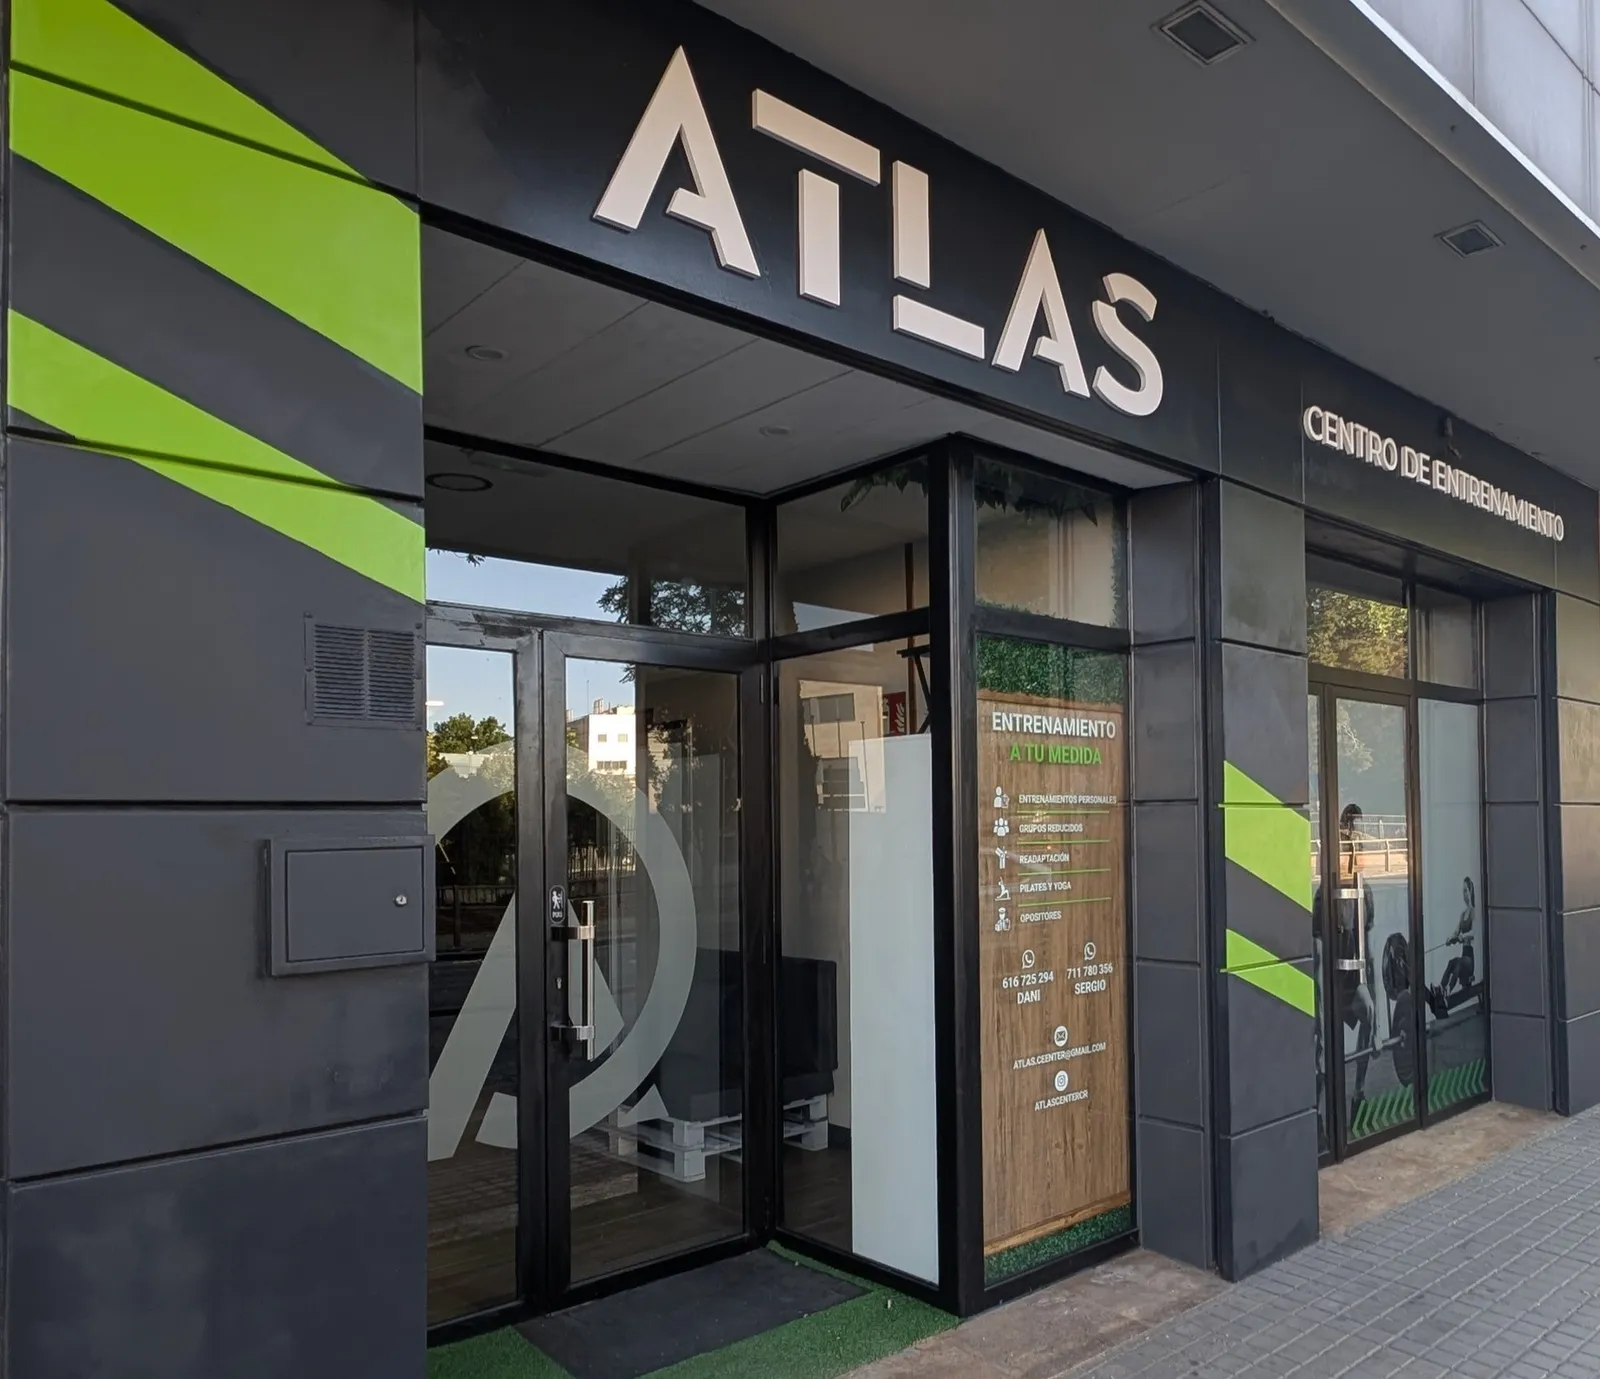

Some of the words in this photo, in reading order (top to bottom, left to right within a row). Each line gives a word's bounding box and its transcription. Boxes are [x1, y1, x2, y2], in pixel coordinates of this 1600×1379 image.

[592, 44, 1163, 417] ATLAS
[1303, 405, 1398, 472] CENTRO
[1400, 445, 1431, 486] DE
[1432, 459, 1565, 542] ENTRENAMIENTO
[991, 711, 1117, 739] ENTRENAMIENTO
[1010, 743, 1021, 761] A
[1025, 743, 1045, 763] TU
[1048, 746, 1102, 765] MEDIDA
[1018, 794, 1078, 804] ENTRENAMIENTOS
[1078, 795, 1117, 805] PERSONALES
[1019, 823, 1047, 833] GRUPOS
[1047, 824, 1083, 833] REDUCIDOS
[1019, 851, 1070, 864] READAPTACIÓN
[1019, 882, 1048, 893] PILATES
[1054, 881, 1072, 891] YOGA
[1019, 911, 1062, 923] OPOSITORES
[1066, 967, 1081, 979] 711
[1083, 964, 1098, 977] 780
[1098, 962, 1113, 975] 356
[1002, 976, 1019, 989] 616
[1020, 973, 1037, 987] 725
[1038, 971, 1054, 984] 294
[1074, 979, 1106, 995] SERGIO
[1017, 989, 1041, 1005] DANI
